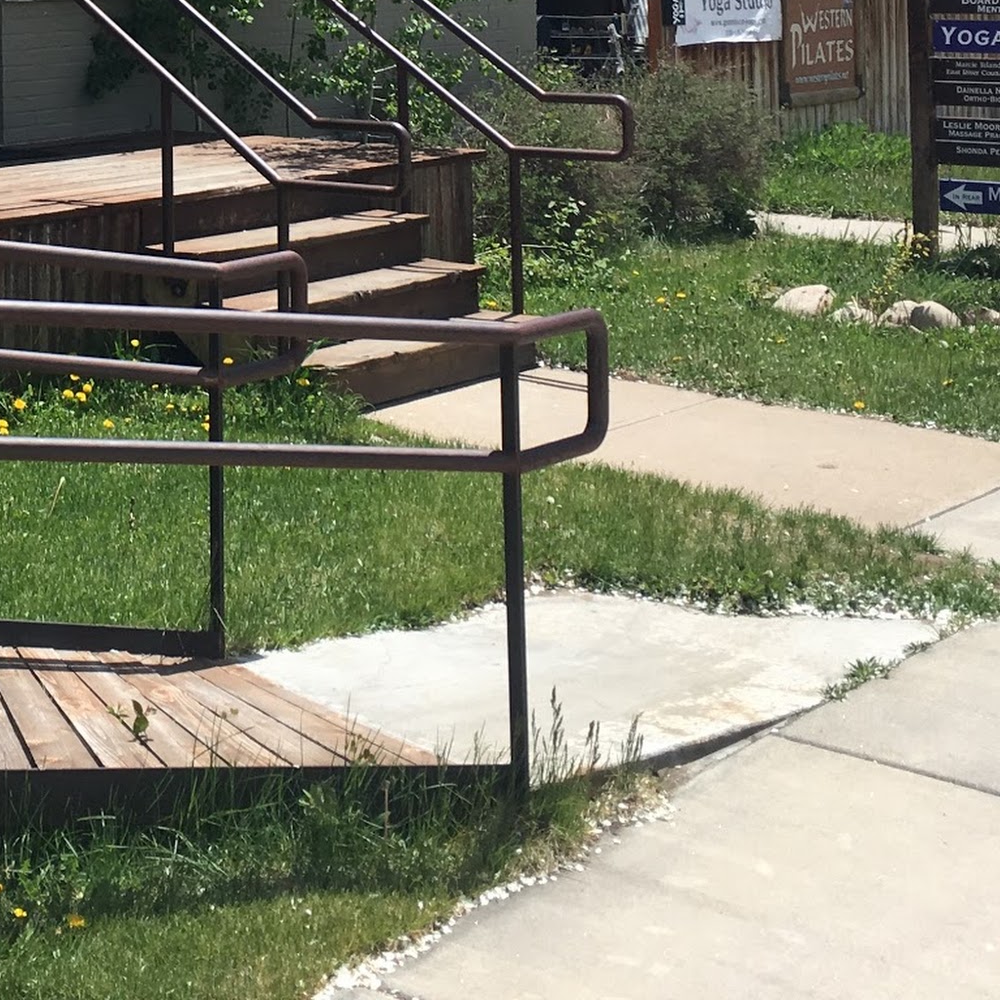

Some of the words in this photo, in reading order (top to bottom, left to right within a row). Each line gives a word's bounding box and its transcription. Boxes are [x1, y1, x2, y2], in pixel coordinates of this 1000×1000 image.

[799, 3, 853, 33] WESTERN
[790, 23, 854, 69] PILATES
[940, 26, 1000, 46] YOGA
[943, 120, 972, 130] LESLIE
